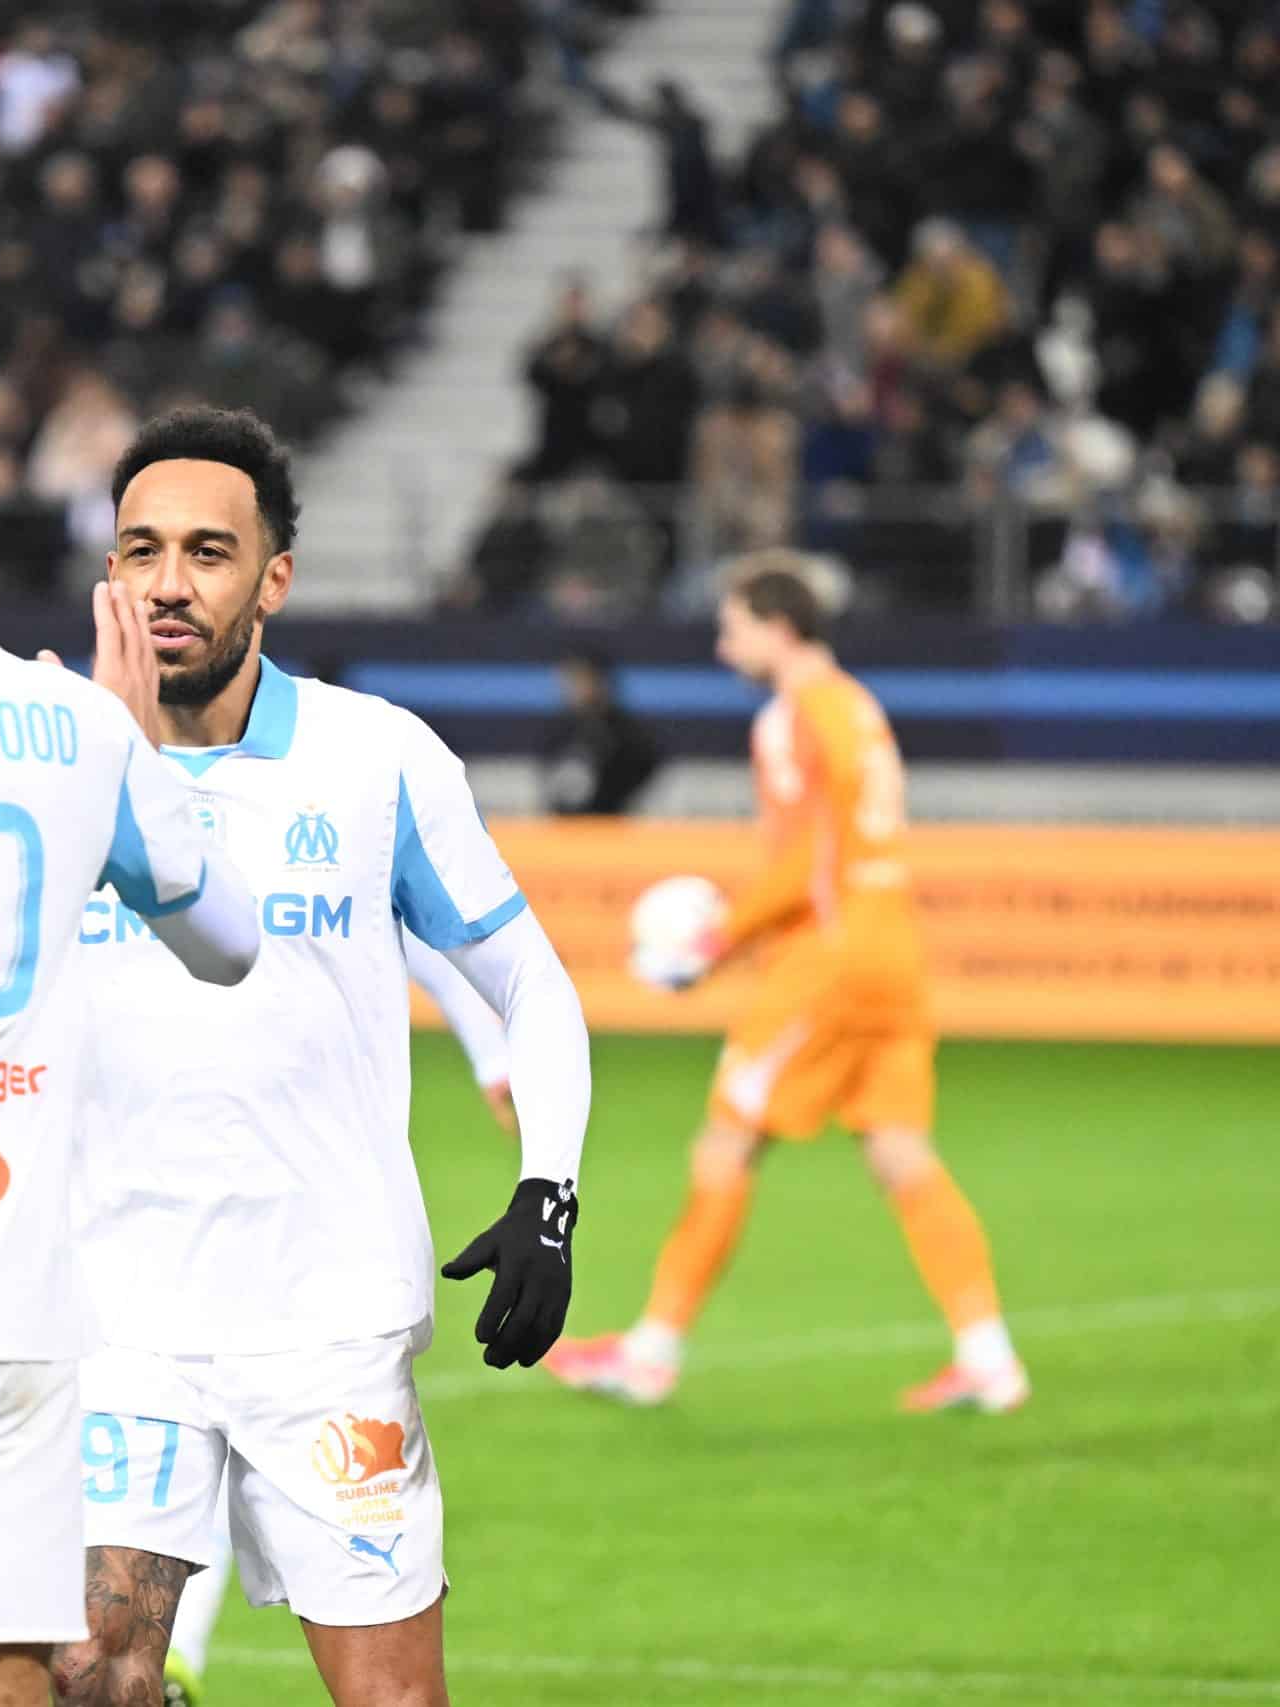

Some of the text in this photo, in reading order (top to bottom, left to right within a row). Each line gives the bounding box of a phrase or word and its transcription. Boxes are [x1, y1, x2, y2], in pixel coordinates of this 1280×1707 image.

[78, 893, 353, 944] CM GM
[79, 1412, 179, 1508] 97
